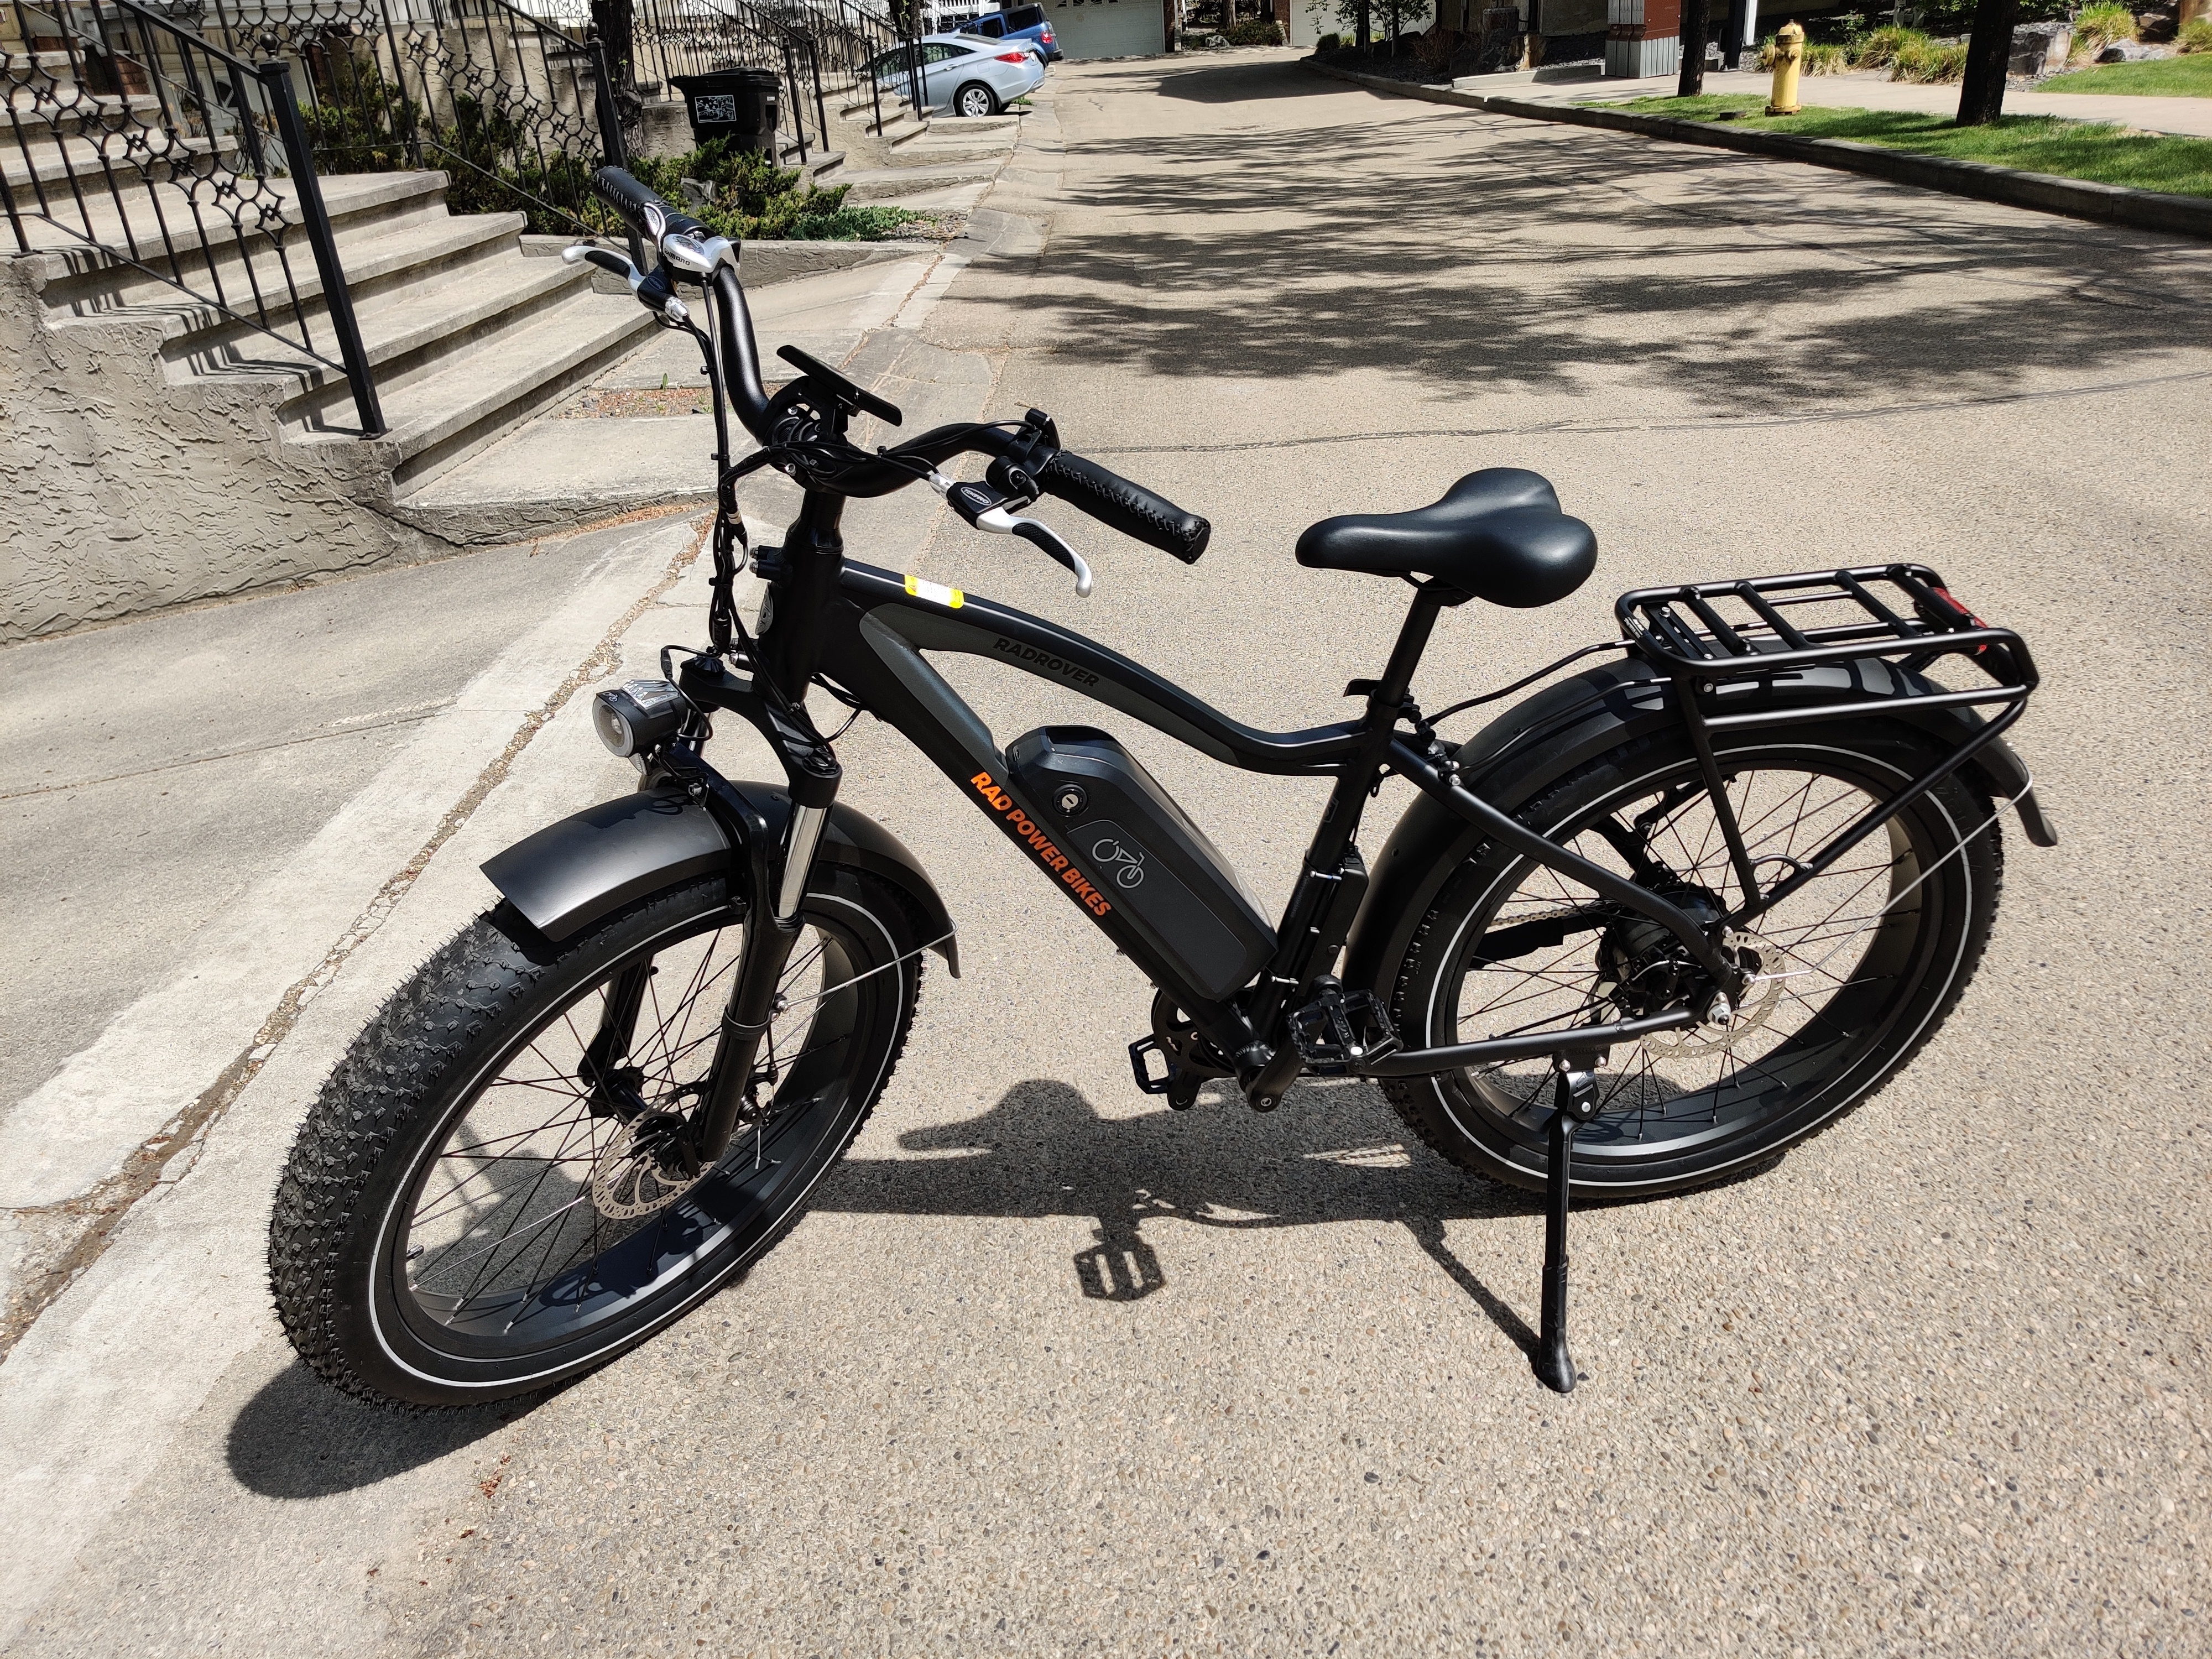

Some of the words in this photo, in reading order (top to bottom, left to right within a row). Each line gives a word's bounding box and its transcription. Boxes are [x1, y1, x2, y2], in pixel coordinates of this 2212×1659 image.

[664, 248, 691, 266] SHIMANO
[993, 638, 1099, 687] RADROVER
[971, 771, 1013, 811] RAD
[1006, 808, 1069, 872] POWER
[1062, 868, 1112, 916] BIKES
